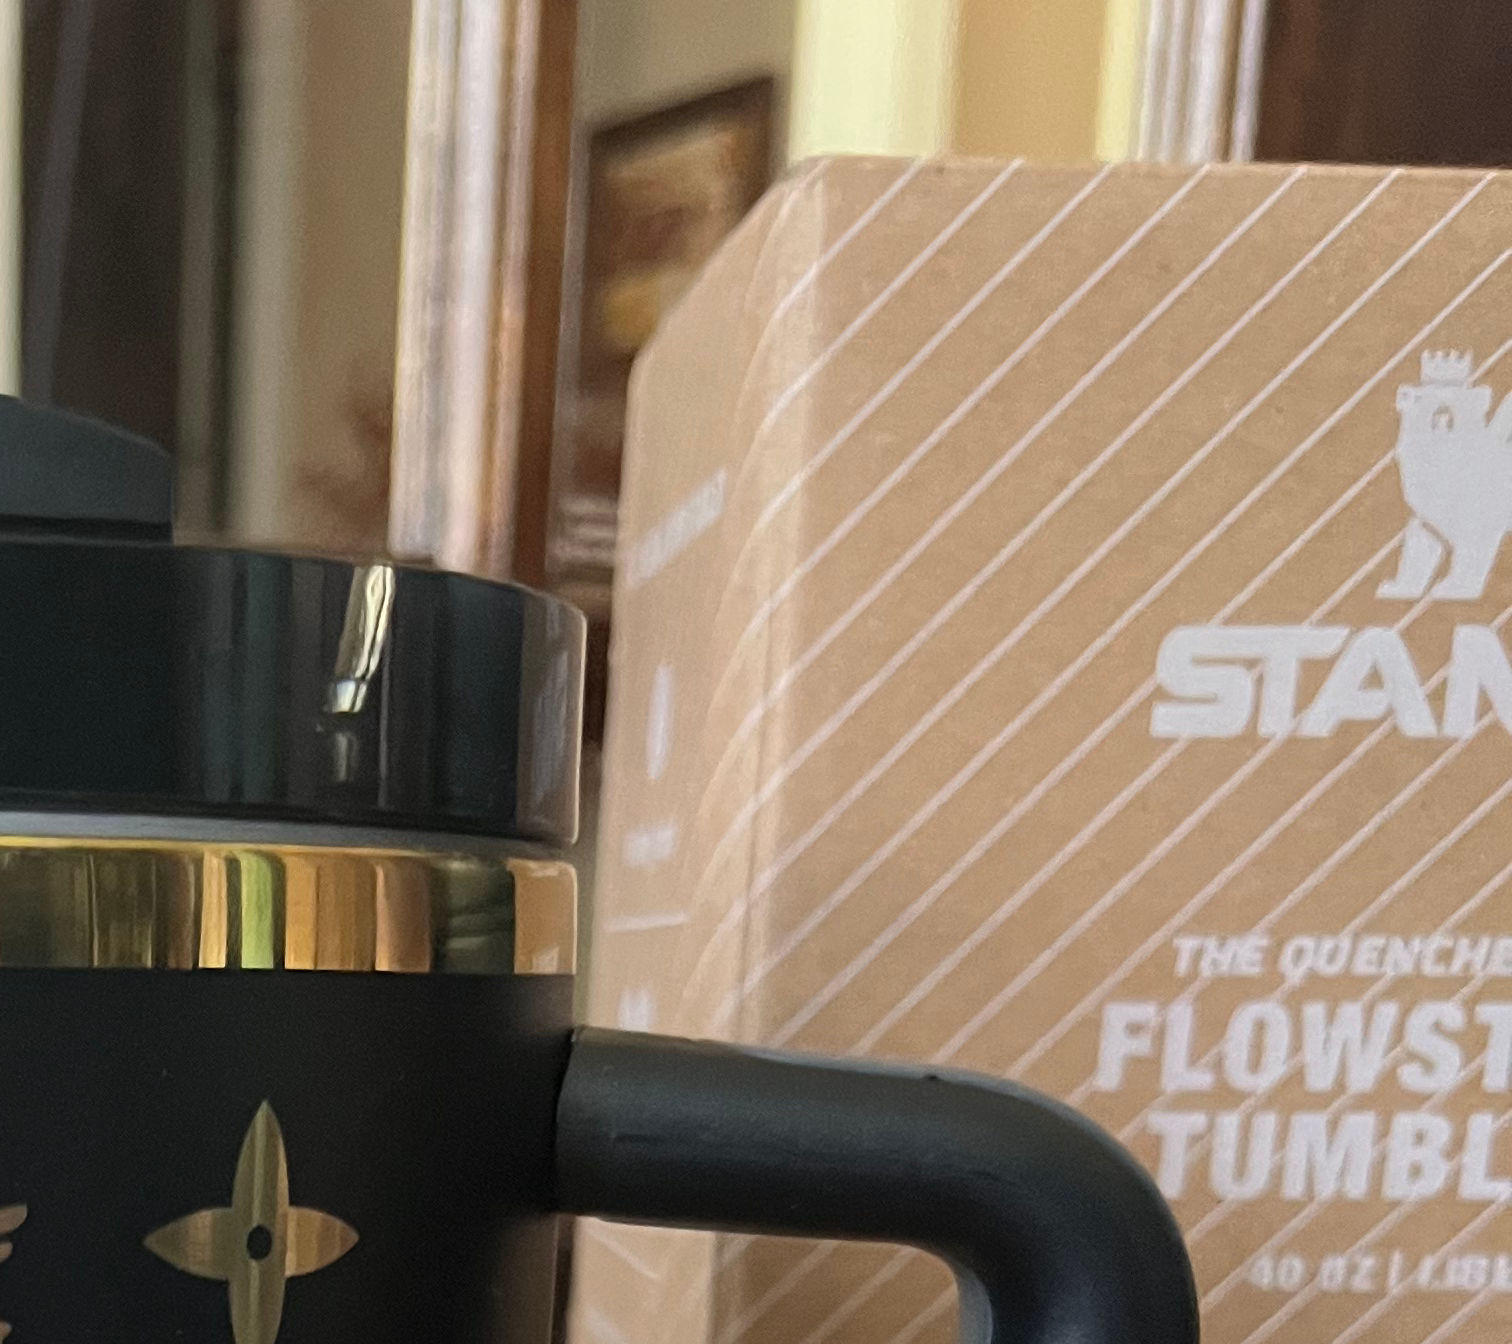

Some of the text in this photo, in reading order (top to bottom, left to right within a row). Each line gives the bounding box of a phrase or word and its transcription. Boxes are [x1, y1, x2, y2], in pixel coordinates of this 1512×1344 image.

[1173, 934, 1270, 978] THE
[1146, 1109, 1512, 1201] TUMBL
[1250, 1251, 1305, 1292] 40
